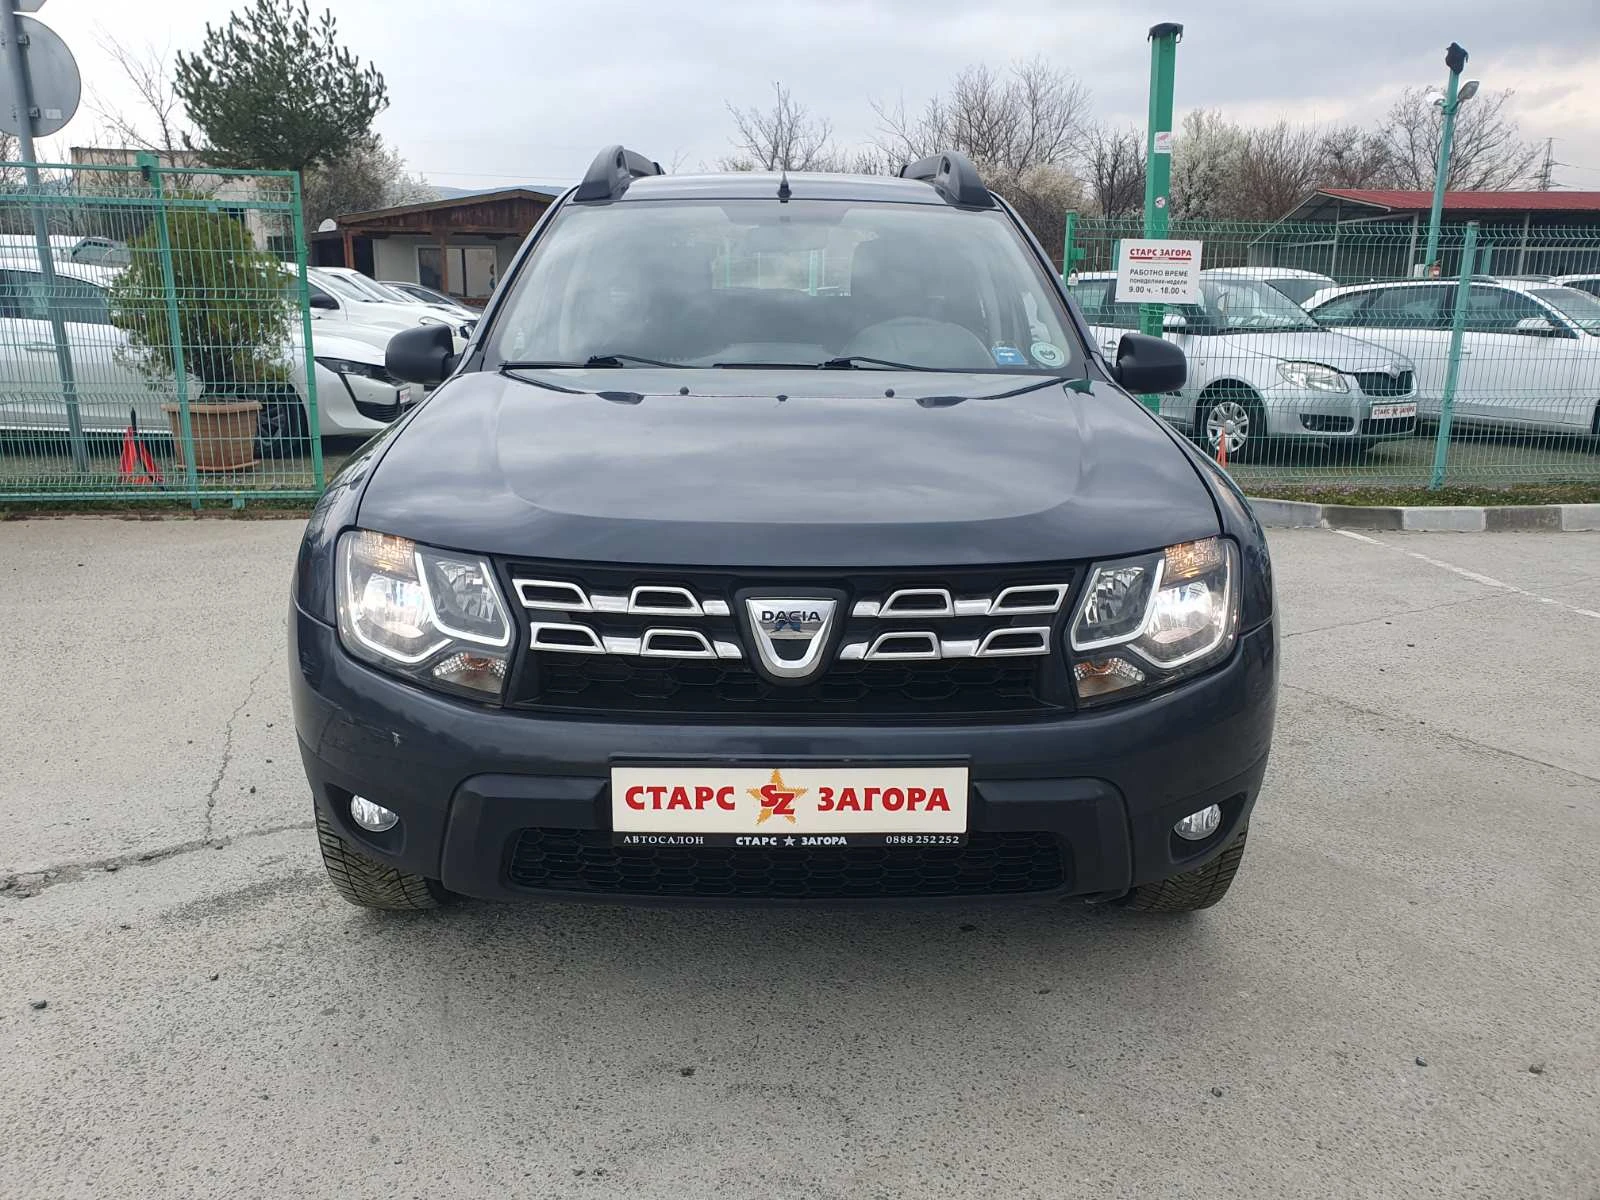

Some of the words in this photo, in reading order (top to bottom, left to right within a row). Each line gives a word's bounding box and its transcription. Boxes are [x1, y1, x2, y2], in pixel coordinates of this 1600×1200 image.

[761, 610, 821, 622] DACIA
[625, 786, 736, 811] СТАРС
[760, 784, 796, 815] SZ
[817, 787, 951, 812] ЗАГОРА
[623, 835, 704, 845] АВТОСАЛОН
[735, 836, 778, 846] СТАРС
[801, 836, 848, 846] ЗАГОРА
[886, 835, 913, 844] 0888
[915, 835, 936, 844] 252
[938, 835, 959, 844] 252
